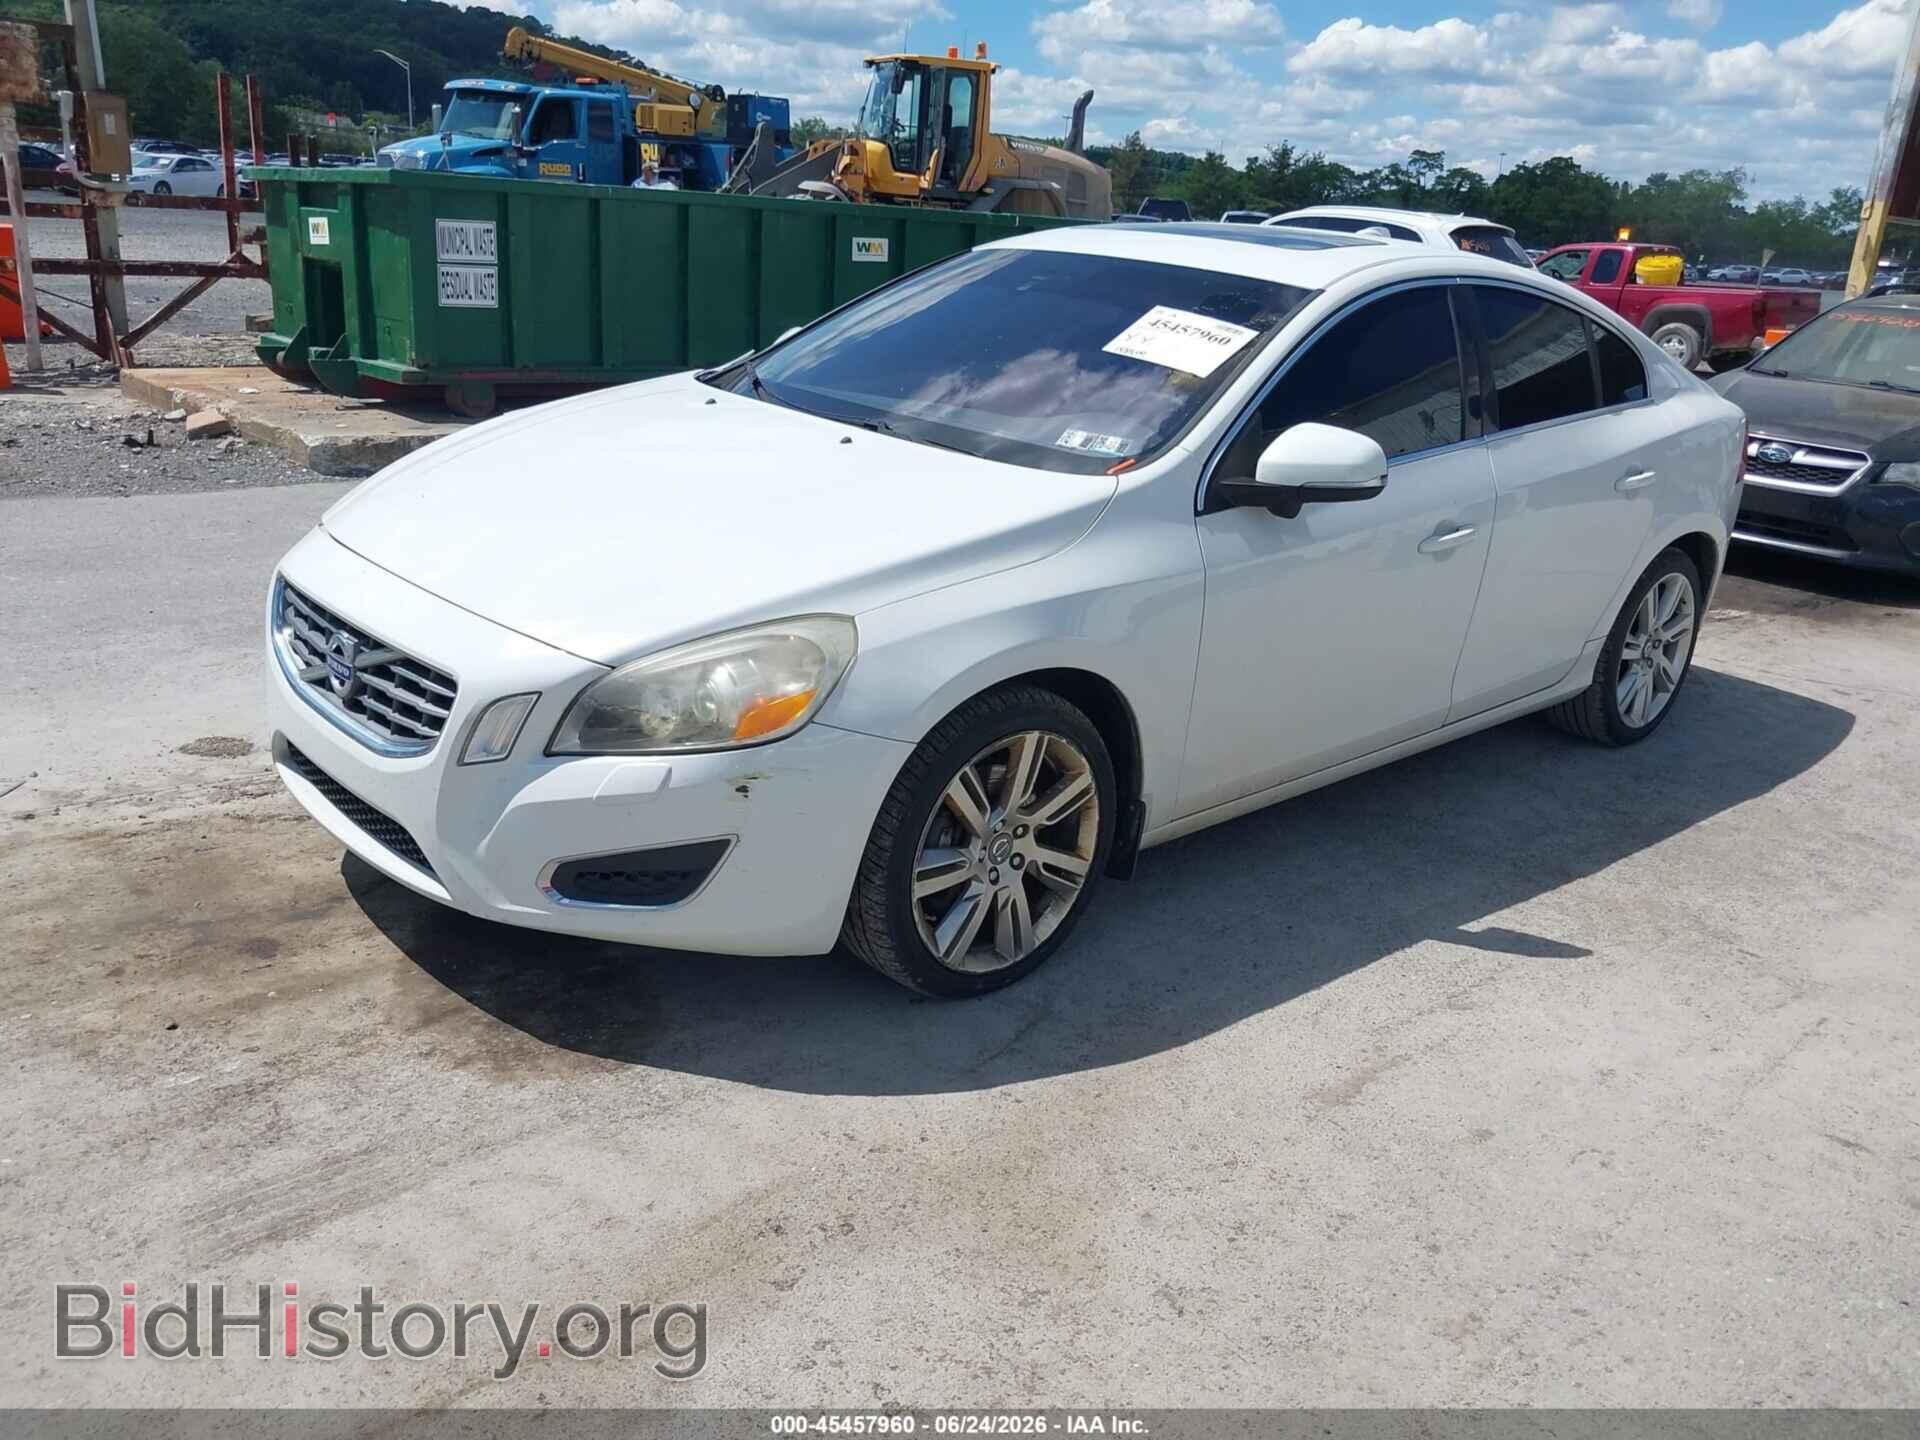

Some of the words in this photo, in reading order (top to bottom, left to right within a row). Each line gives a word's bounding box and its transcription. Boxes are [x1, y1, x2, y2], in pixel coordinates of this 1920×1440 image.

[1011, 142, 1045, 152] VOLVO
[472, 227, 494, 256] WASTE
[441, 271, 473, 300] RESIDUAL
[473, 272, 495, 300] WASTE
[1149, 318, 1232, 346] 45457960
